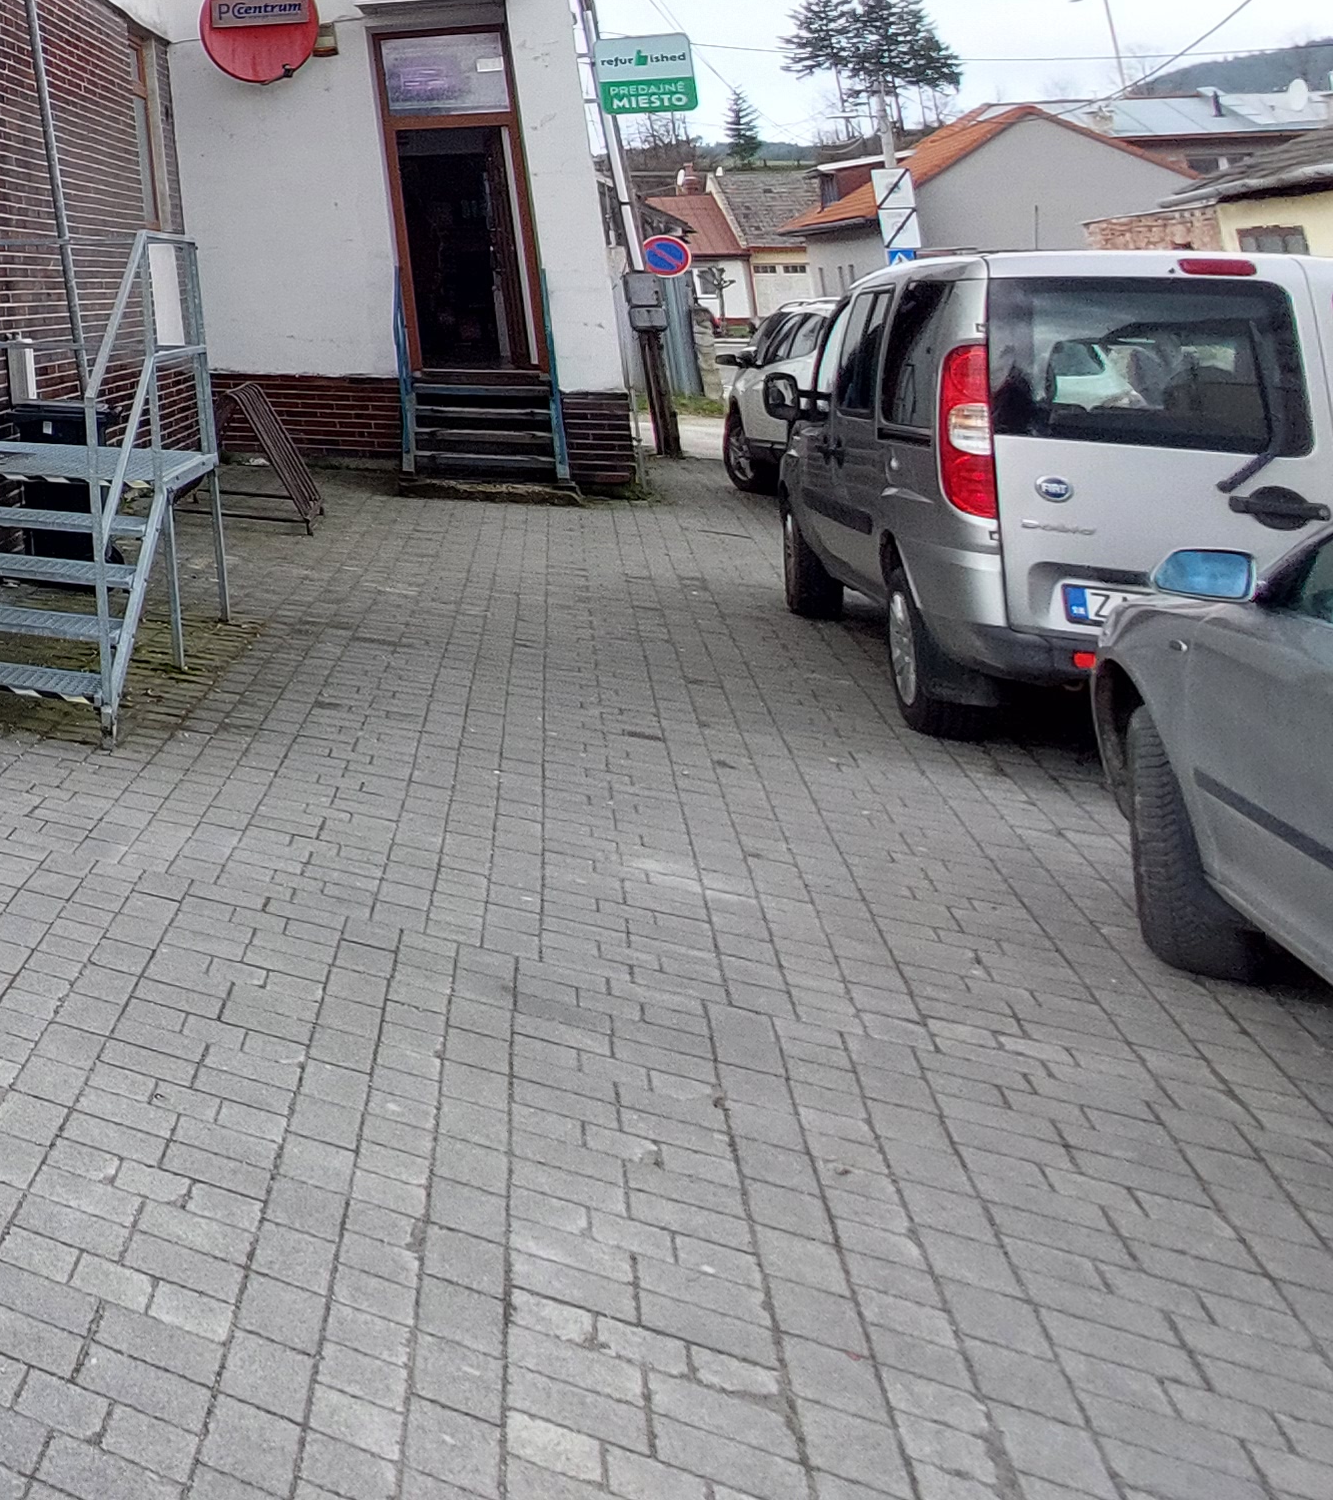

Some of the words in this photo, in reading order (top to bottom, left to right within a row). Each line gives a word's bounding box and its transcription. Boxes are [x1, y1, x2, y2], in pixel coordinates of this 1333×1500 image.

[609, 80, 685, 96] PREDAJNÉ
[612, 94, 688, 109] MIESTO
[1041, 482, 1068, 495] FIAT
